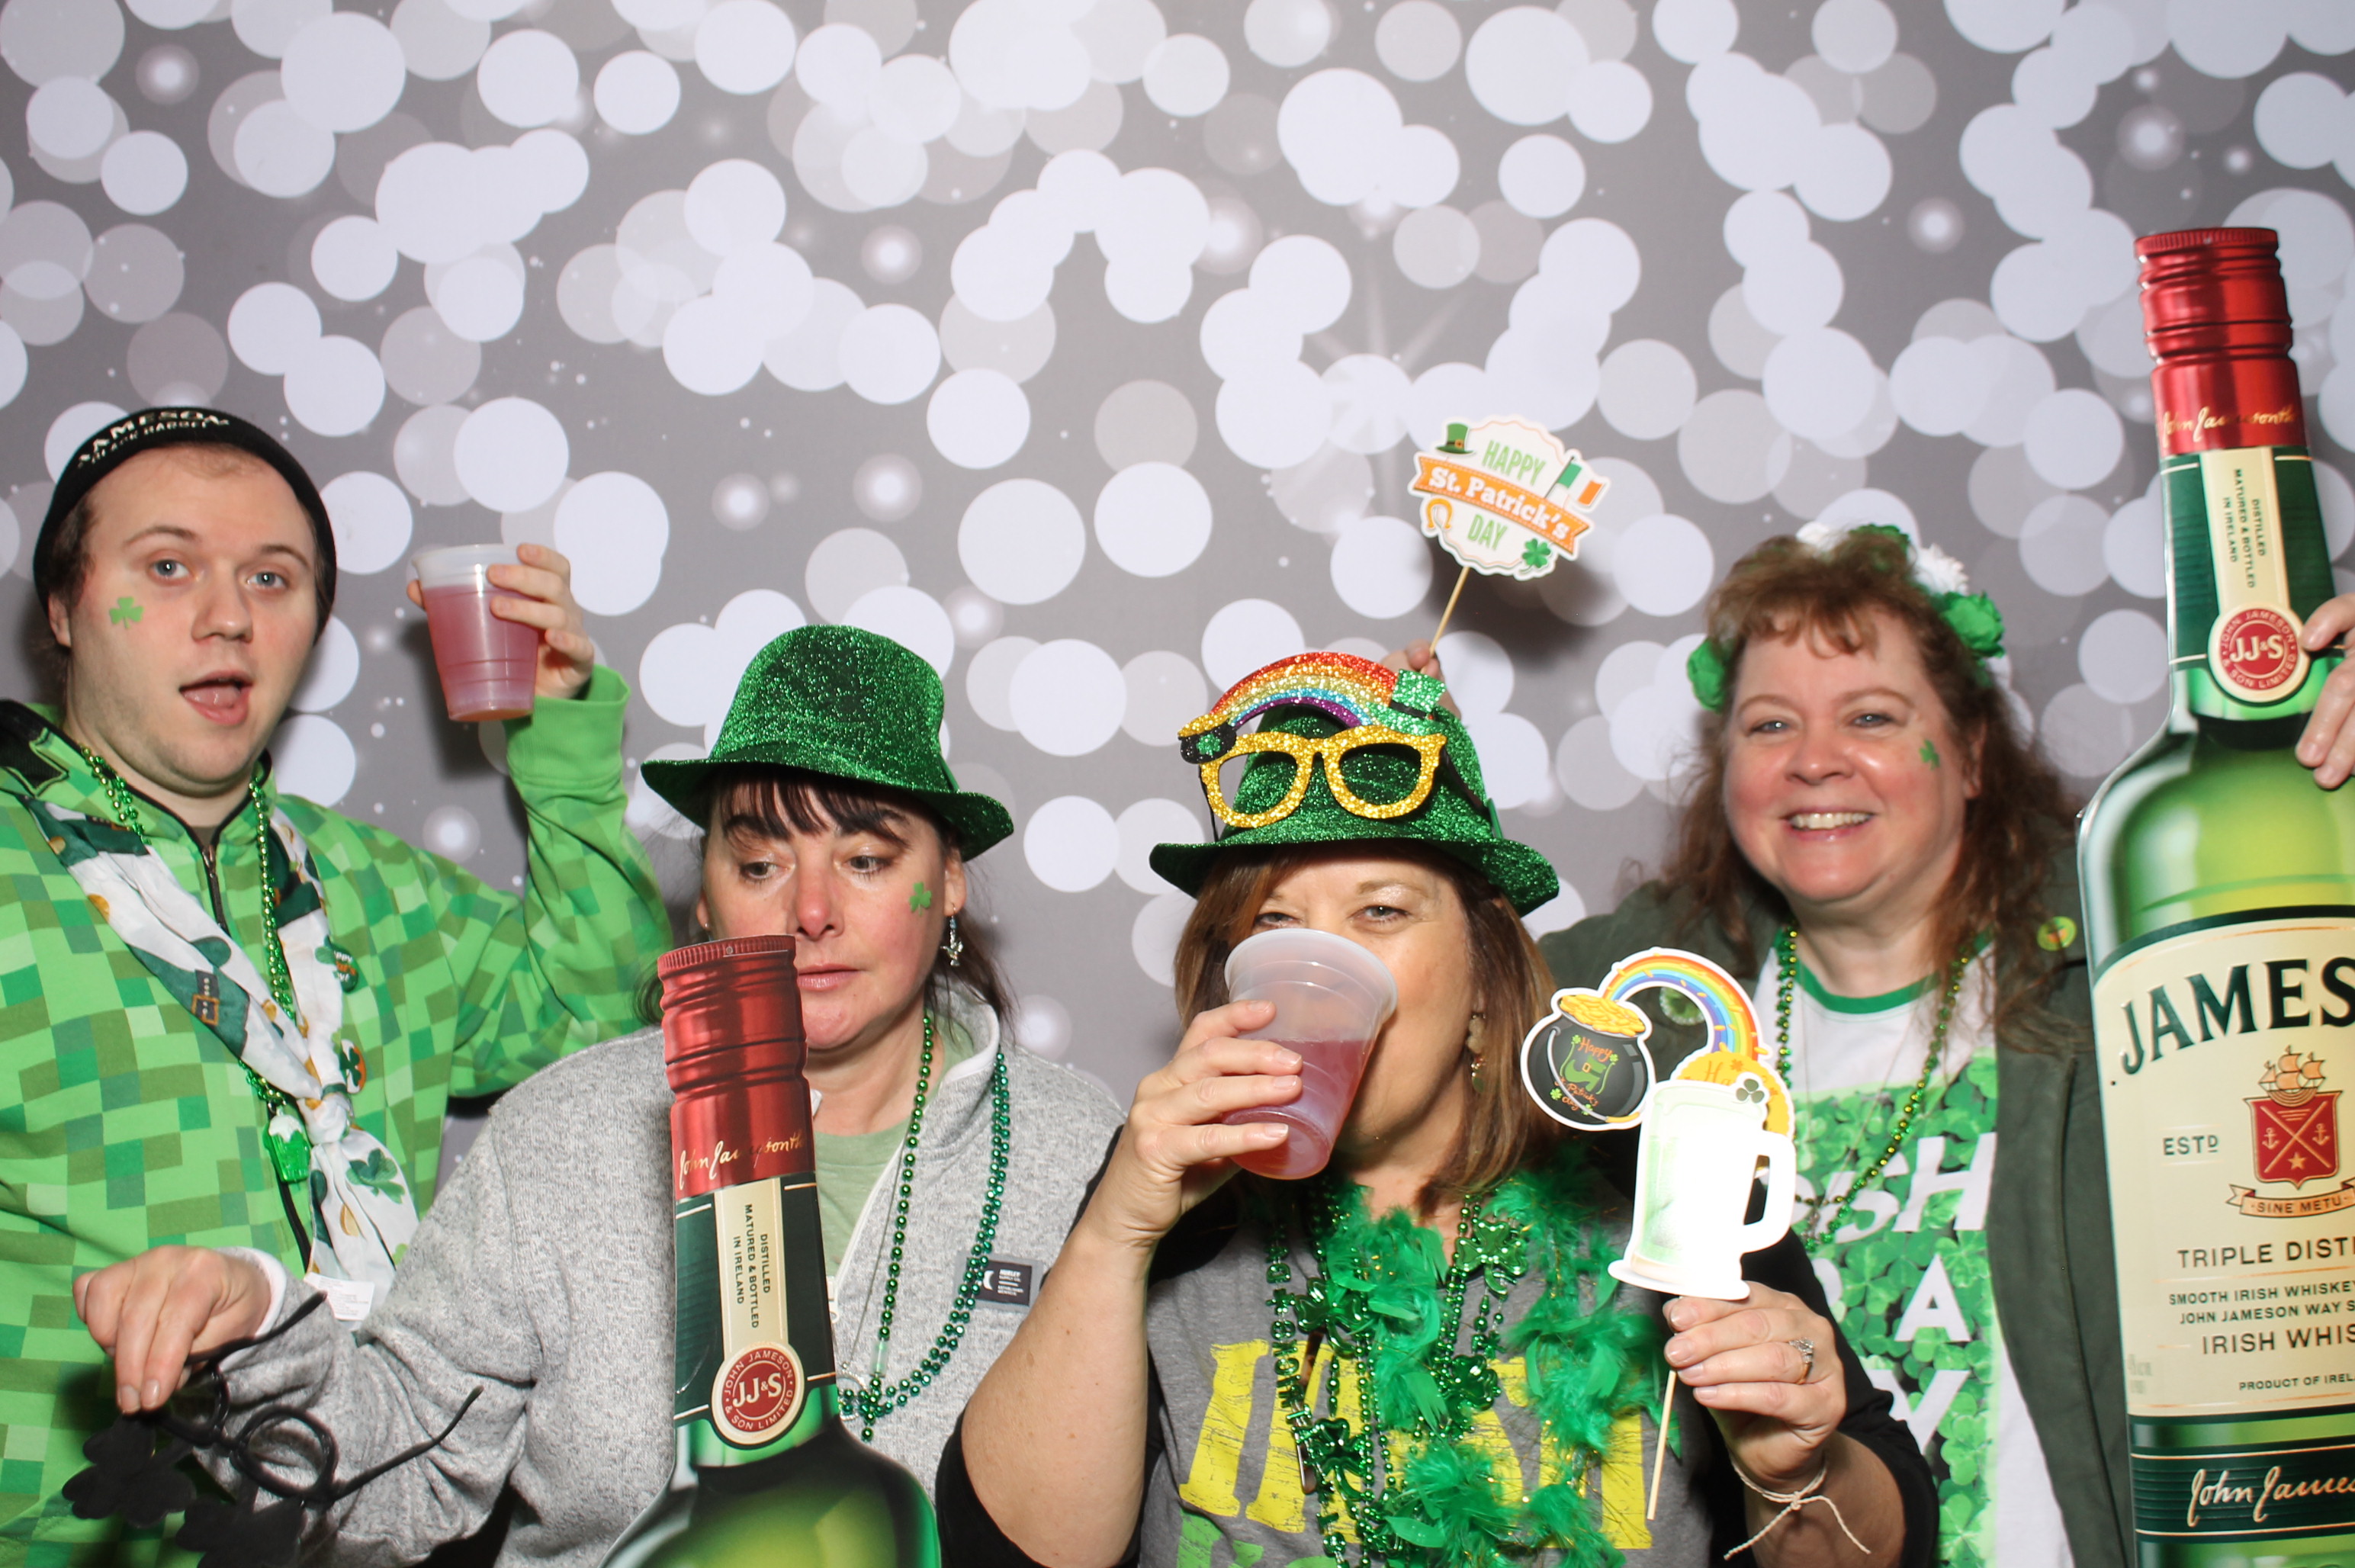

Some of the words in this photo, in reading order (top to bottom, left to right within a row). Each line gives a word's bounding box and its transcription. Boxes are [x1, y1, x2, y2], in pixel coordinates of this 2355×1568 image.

[1482, 440, 1546, 486] HAPPY
[1428, 467, 1461, 493] St.
[1465, 477, 1571, 539] Patrick's
[2223, 497, 2231, 508] IN
[1467, 514, 1508, 551] DAY
[2225, 512, 2238, 562] IRELAND
[2234, 468, 2247, 522] MATURED
[2242, 537, 2255, 588] BOTTLED
[2251, 499, 2266, 556] DISTILLED
[2221, 618, 2242, 649] JOHN
[2245, 610, 2295, 643] JAMESON
[2229, 634, 2283, 663] JJ&S
[2229, 669, 2254, 687] SON
[2258, 654, 2296, 688] LIMITED
[2120, 957, 2355, 1075] JAMES
[1578, 1036, 1613, 1062] Happy
[2257, 1202, 2293, 1213] SINE
[2300, 1195, 2341, 1212] METU
[733, 1235, 741, 1248] IN
[745, 1203, 756, 1261] MATURED
[748, 1264, 757, 1273] &
[760, 1234, 770, 1293] DISTILLED
[2177, 1244, 2273, 1268] TRIPLE
[734, 1252, 744, 1304] IRELAND
[2169, 1291, 2228, 1305] SMOOTH
[2235, 1287, 2278, 1302] IRISH
[749, 1275, 759, 1329] BOTTLED
[2180, 1312, 2216, 1325] JOHN
[2222, 1306, 2299, 1322] JAMESON
[2305, 1301, 2341, 1316] WAY
[2202, 1332, 2275, 1354] IRISH
[724, 1361, 744, 1395] JOHN
[748, 1350, 793, 1378] JAMESON
[732, 1372, 782, 1407] JJ&S
[2239, 1377, 2299, 1390] PRODUCT
[2304, 1375, 2320, 1386] OF
[2324, 1373, 2355, 1384] IREL
[724, 1406, 733, 1415] &
[731, 1415, 753, 1431] SON
[758, 1390, 793, 1429] LIMITED
[2187, 1468, 2254, 1528] John
